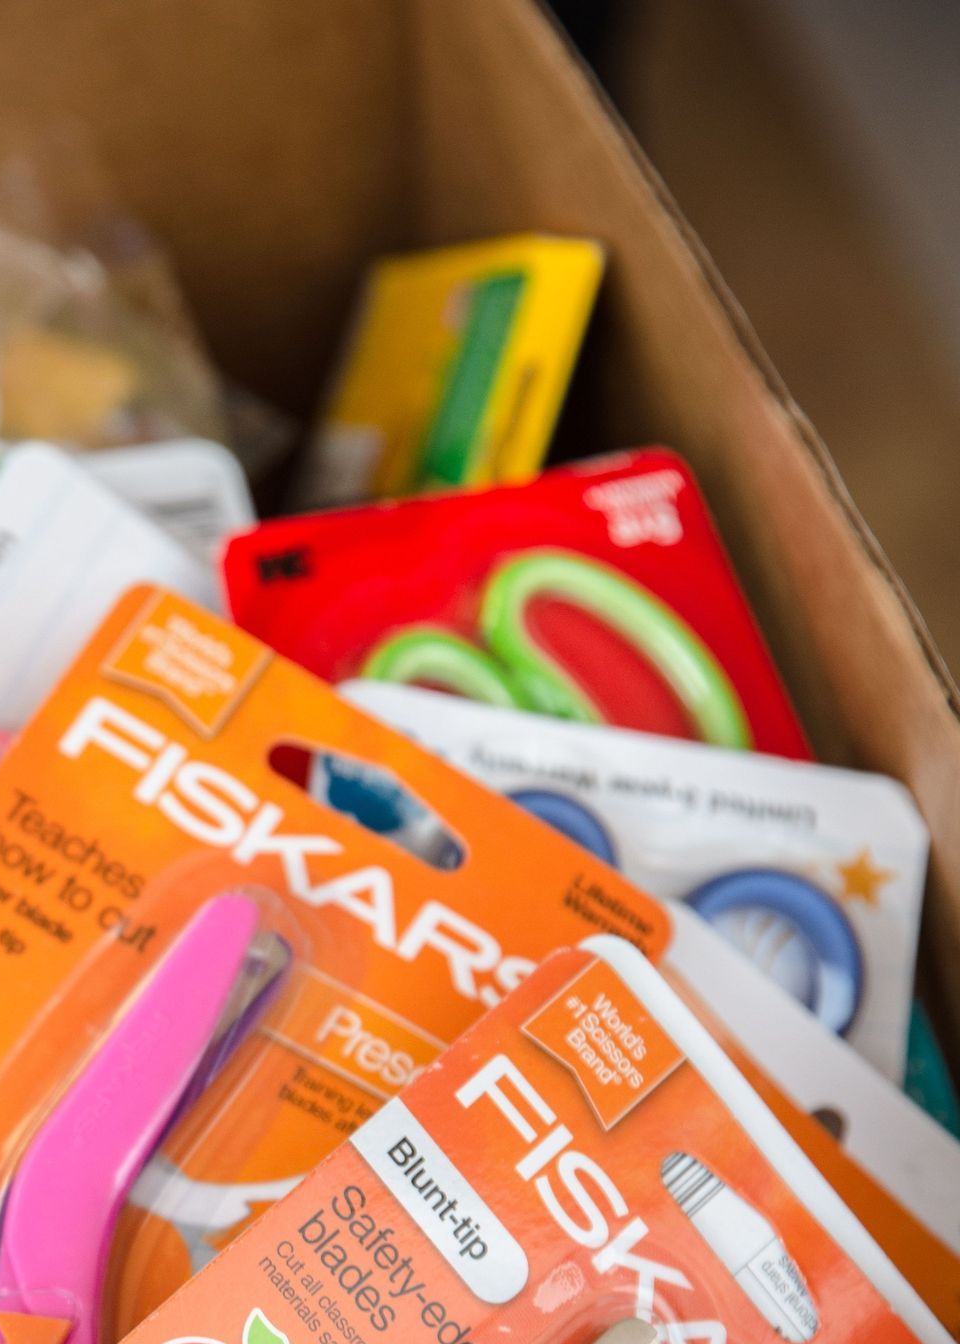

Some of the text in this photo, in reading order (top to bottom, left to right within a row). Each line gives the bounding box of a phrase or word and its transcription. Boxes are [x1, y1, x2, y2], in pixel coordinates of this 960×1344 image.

[5, 789, 146, 901] Teaches
[13, 896, 75, 945] blade
[60, 874, 94, 913] to
[96, 896, 158, 953] cut
[565, 995, 644, 1091] #1 Scissors
[592, 991, 649, 1061] World's
[386, 1135, 488, 1262] Blunt-tip
[259, 1253, 320, 1333] materials
[276, 1240, 302, 1271] Cut
[300, 1266, 323, 1294] all
[298, 1209, 396, 1332] blades
